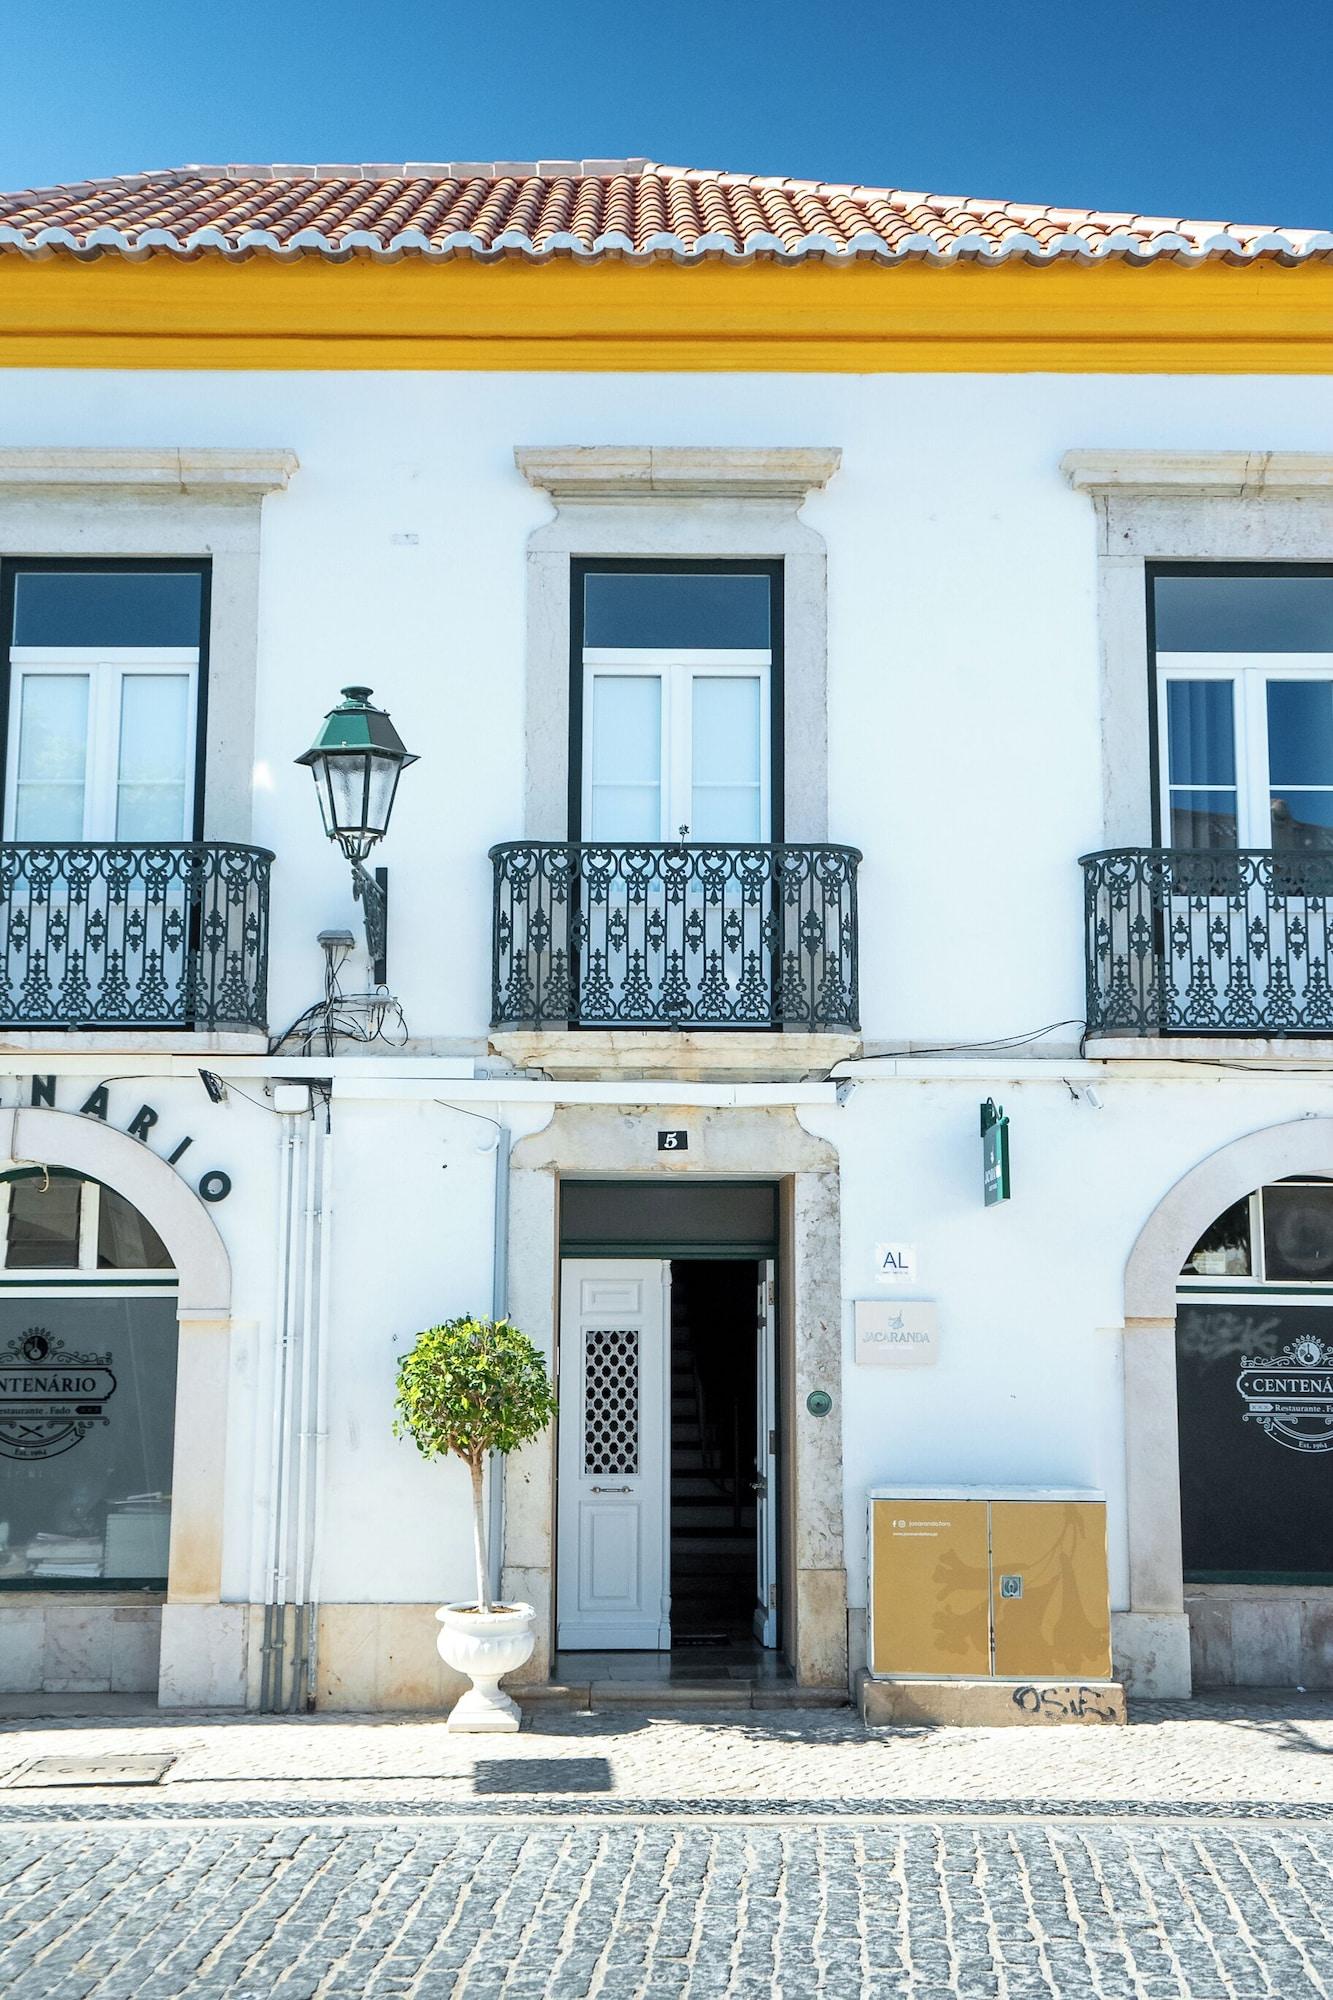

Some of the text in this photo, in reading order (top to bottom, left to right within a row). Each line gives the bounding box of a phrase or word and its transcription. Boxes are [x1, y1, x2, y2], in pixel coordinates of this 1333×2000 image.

[0, 1075, 232, 1202] NARIO
[664, 1132, 678, 1148] 5
[883, 1251, 909, 1268] AL
[50, 1406, 71, 1415] Fado
[1275, 1404, 1321, 1412] Restaurante
